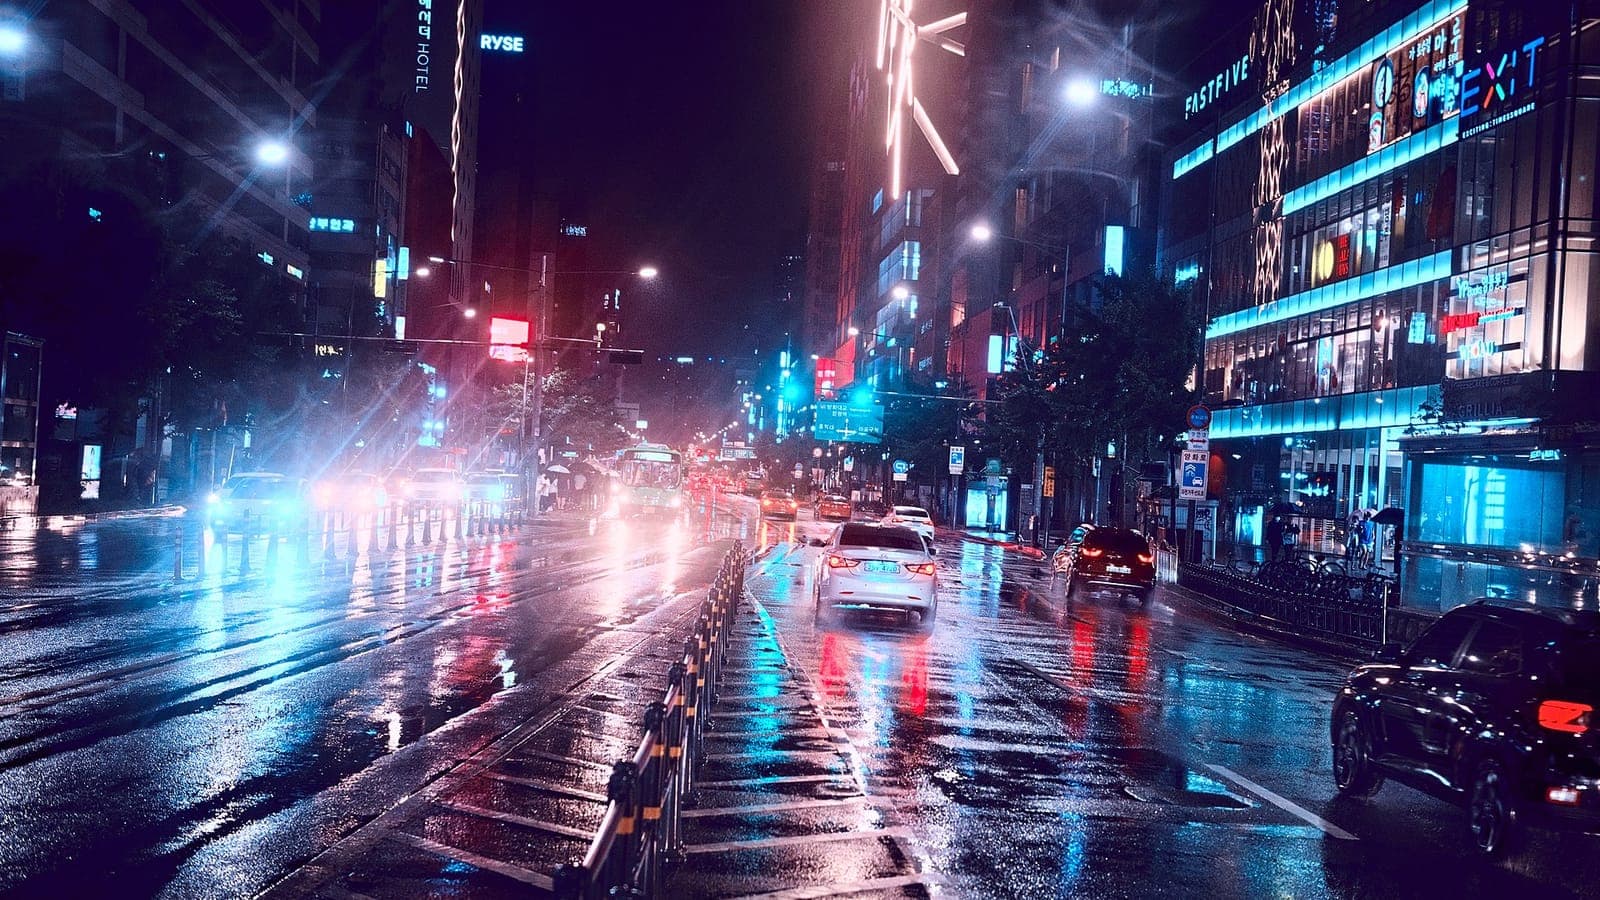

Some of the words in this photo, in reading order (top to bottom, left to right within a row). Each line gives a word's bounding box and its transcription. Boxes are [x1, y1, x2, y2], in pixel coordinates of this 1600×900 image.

[416, 43, 429, 93] HOTEL
[480, 34, 524, 52] RYSE
[1185, 54, 1249, 120] FASTFIVE
[1460, 36, 1545, 117] EXIT
